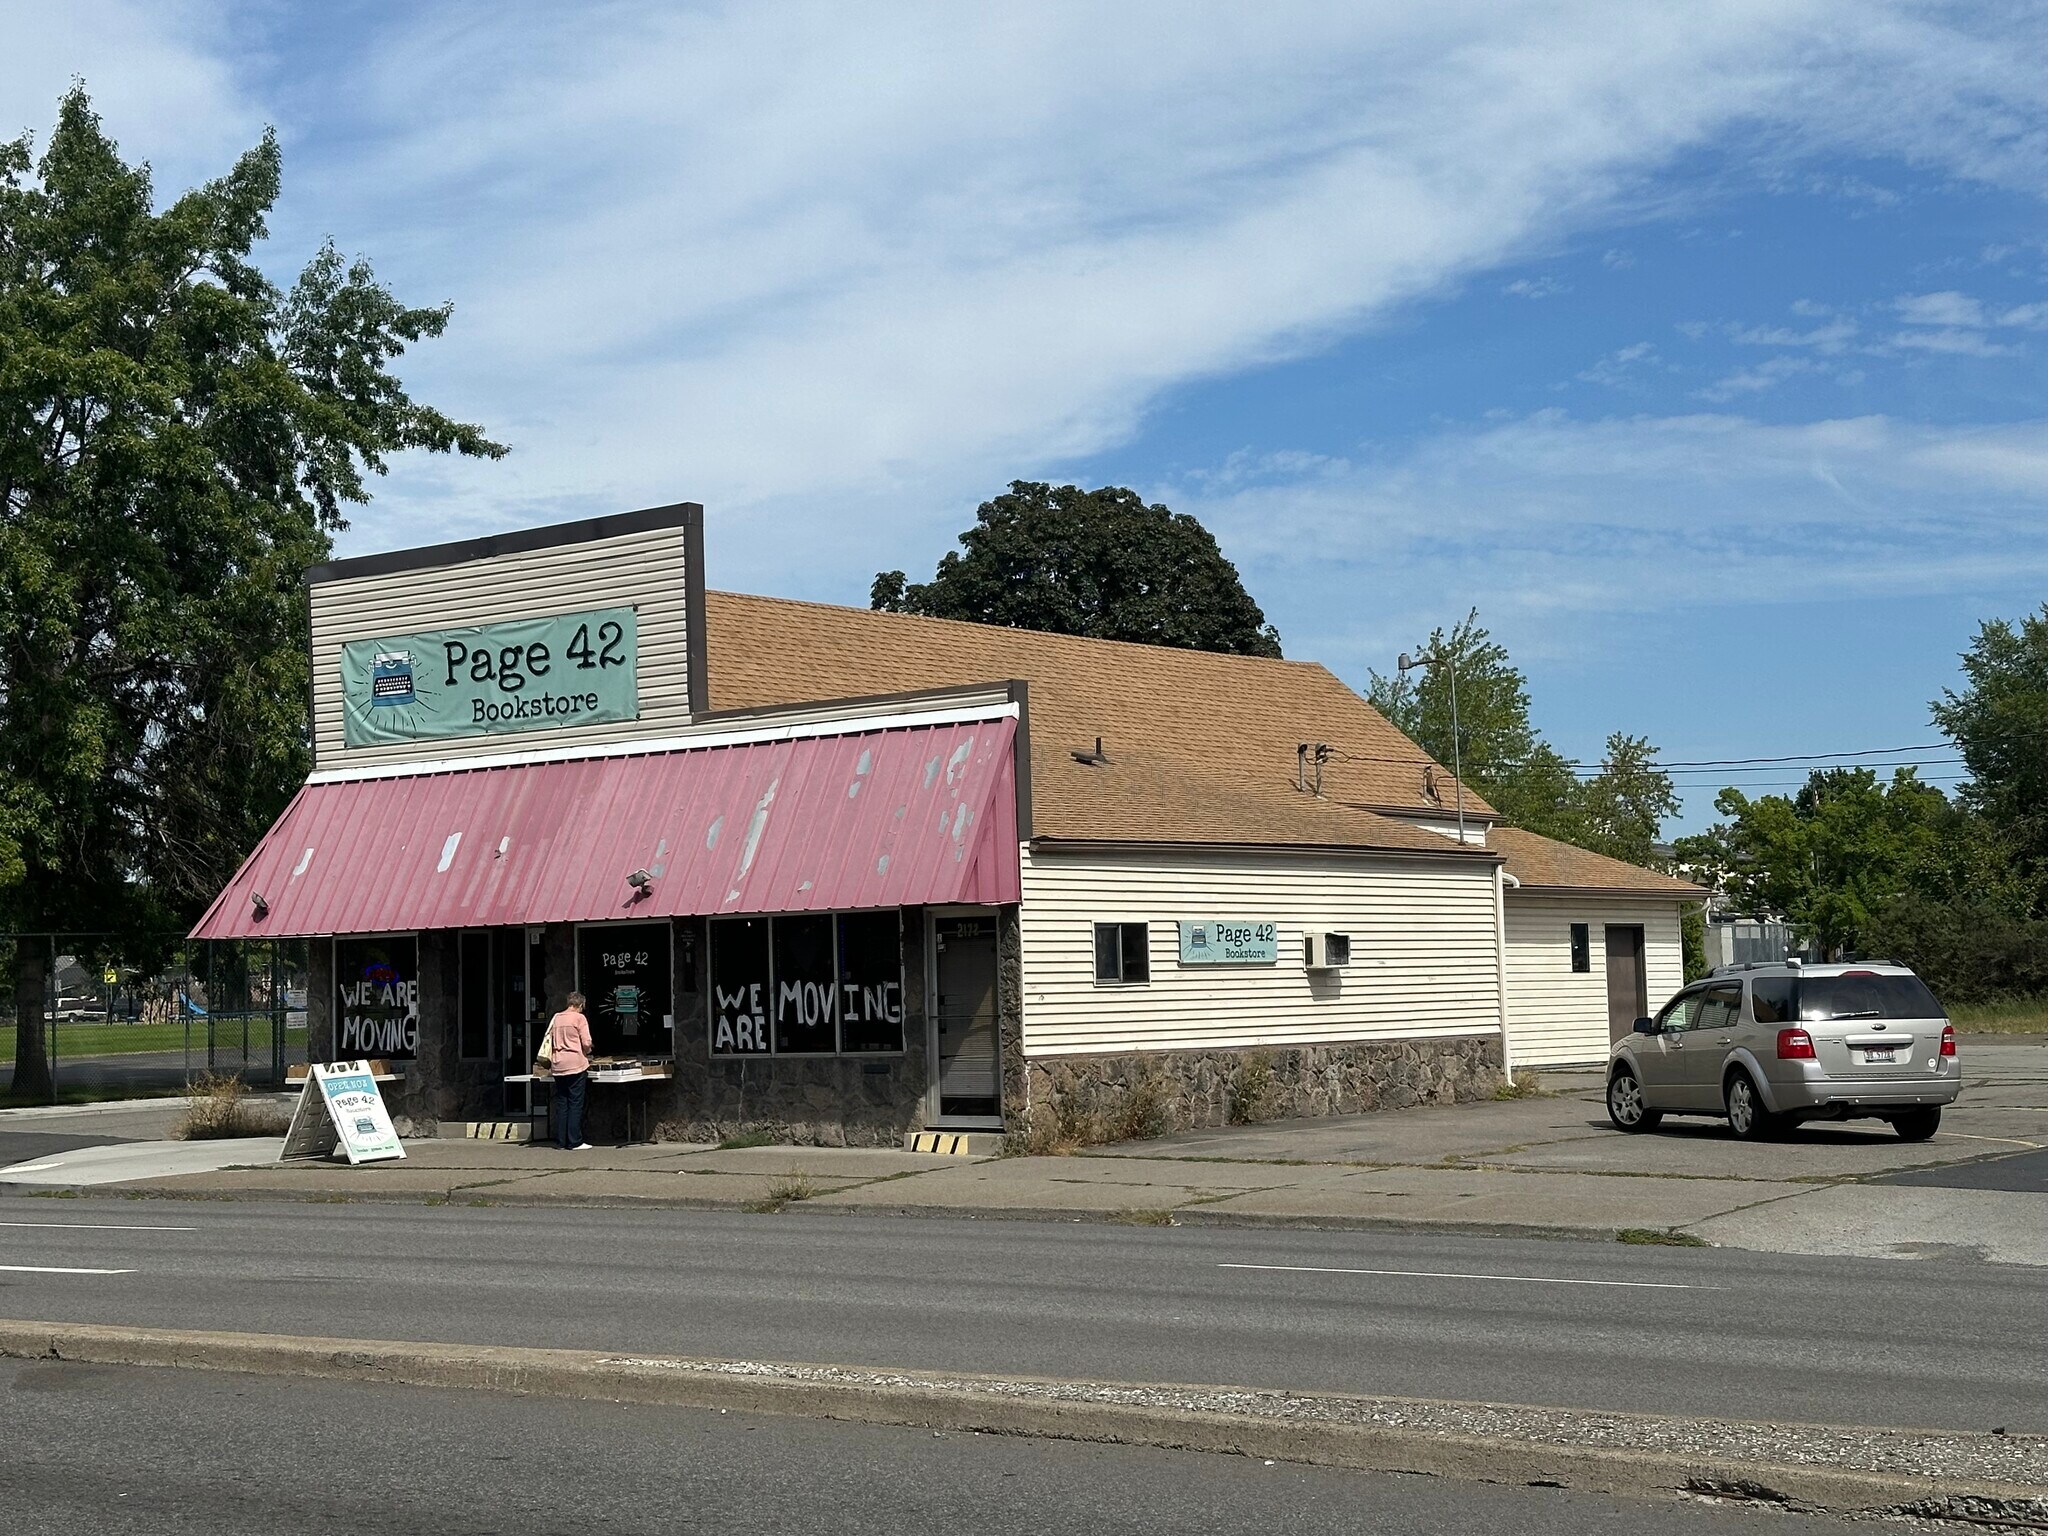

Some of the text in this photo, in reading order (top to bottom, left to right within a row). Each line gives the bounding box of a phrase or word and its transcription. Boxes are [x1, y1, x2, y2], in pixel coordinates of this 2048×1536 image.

[443, 621, 626, 692] Page 42
[471, 692, 598, 723] Bookstore
[1216, 923, 1274, 947] Page 42
[602, 951, 649, 968] Page 42
[1225, 948, 1266, 959] Bookstore
[340, 980, 372, 1008] WE
[380, 980, 417, 1007] ARE
[716, 983, 763, 1014] WE
[778, 979, 901, 1027] MOVING
[341, 1013, 418, 1056] MOVING
[715, 1014, 767, 1050] ARE
[335, 1095, 375, 1109] Page 42
